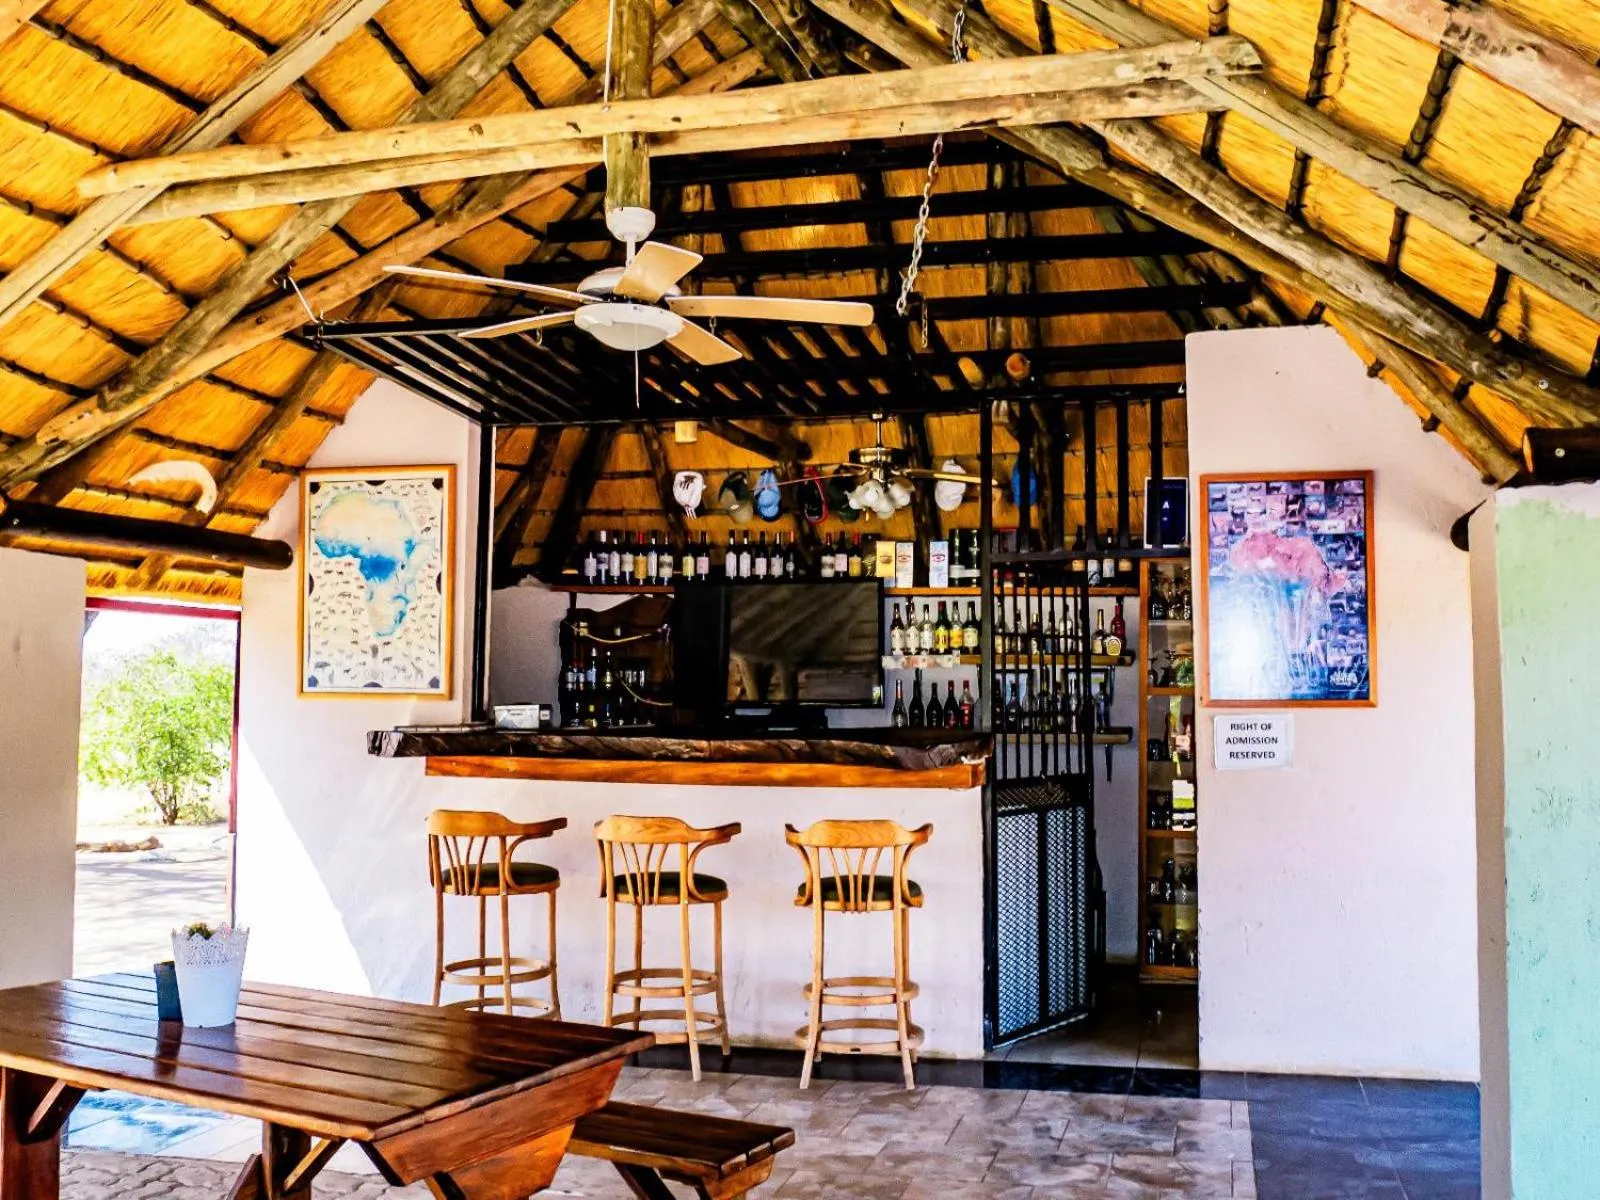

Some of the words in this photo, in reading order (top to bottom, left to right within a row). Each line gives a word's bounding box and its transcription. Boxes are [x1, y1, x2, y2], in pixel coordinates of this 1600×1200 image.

[1230, 723, 1258, 731] RIGHT
[1260, 723, 1273, 731] OF
[1225, 736, 1278, 745] ADMISSION
[1229, 751, 1276, 759] RESERVED
